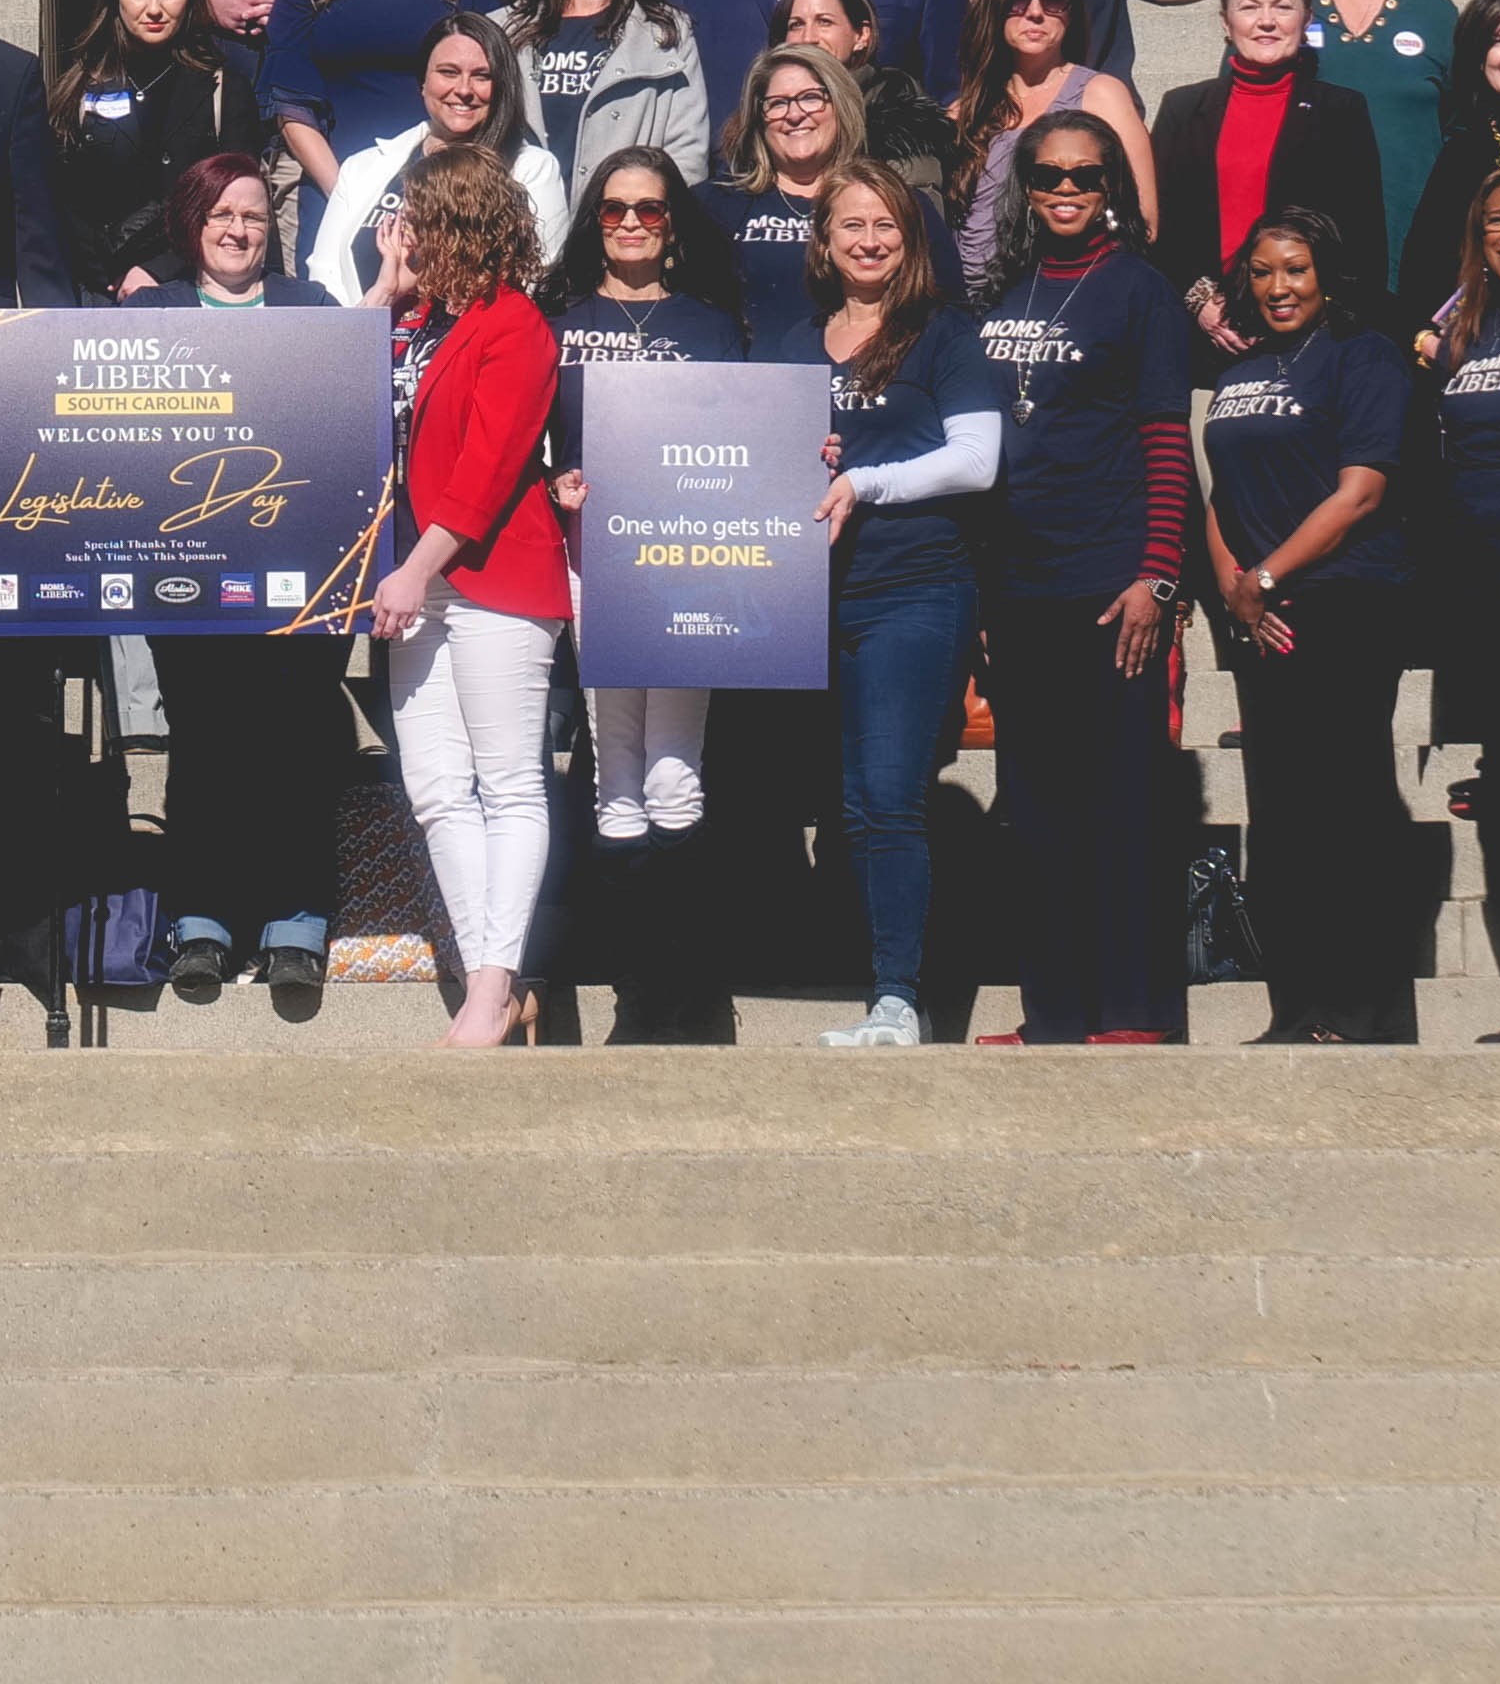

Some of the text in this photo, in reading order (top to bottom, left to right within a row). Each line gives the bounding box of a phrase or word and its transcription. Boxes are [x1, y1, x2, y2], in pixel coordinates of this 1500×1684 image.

[541, 51, 588, 71] OMS
[742, 227, 812, 242] LIBE
[979, 319, 1047, 338] MOMS
[562, 329, 679, 350] MOMS for
[73, 338, 200, 366] MOMS for
[985, 339, 1074, 363] IBERTY
[73, 364, 218, 389] LIBERTY
[1216, 379, 1291, 402] MOMS for
[68, 396, 220, 411] SOUTH CAROLINA
[1205, 395, 1294, 423] LIBERTY
[37, 426, 254, 443] WELCOMES YOU TO
[661, 443, 749, 467] mom
[159, 446, 311, 533] Day
[676, 474, 733, 492] (noun)
[607, 515, 802, 540] One who gets the
[84, 539, 207, 551] Special Thanks To Our
[65, 551, 228, 563] Such A Time As This Sponsors
[634, 544, 773, 567] JOB DONE.
[673, 612, 709, 623] MOMS
[673, 623, 734, 635] LIBERTY
